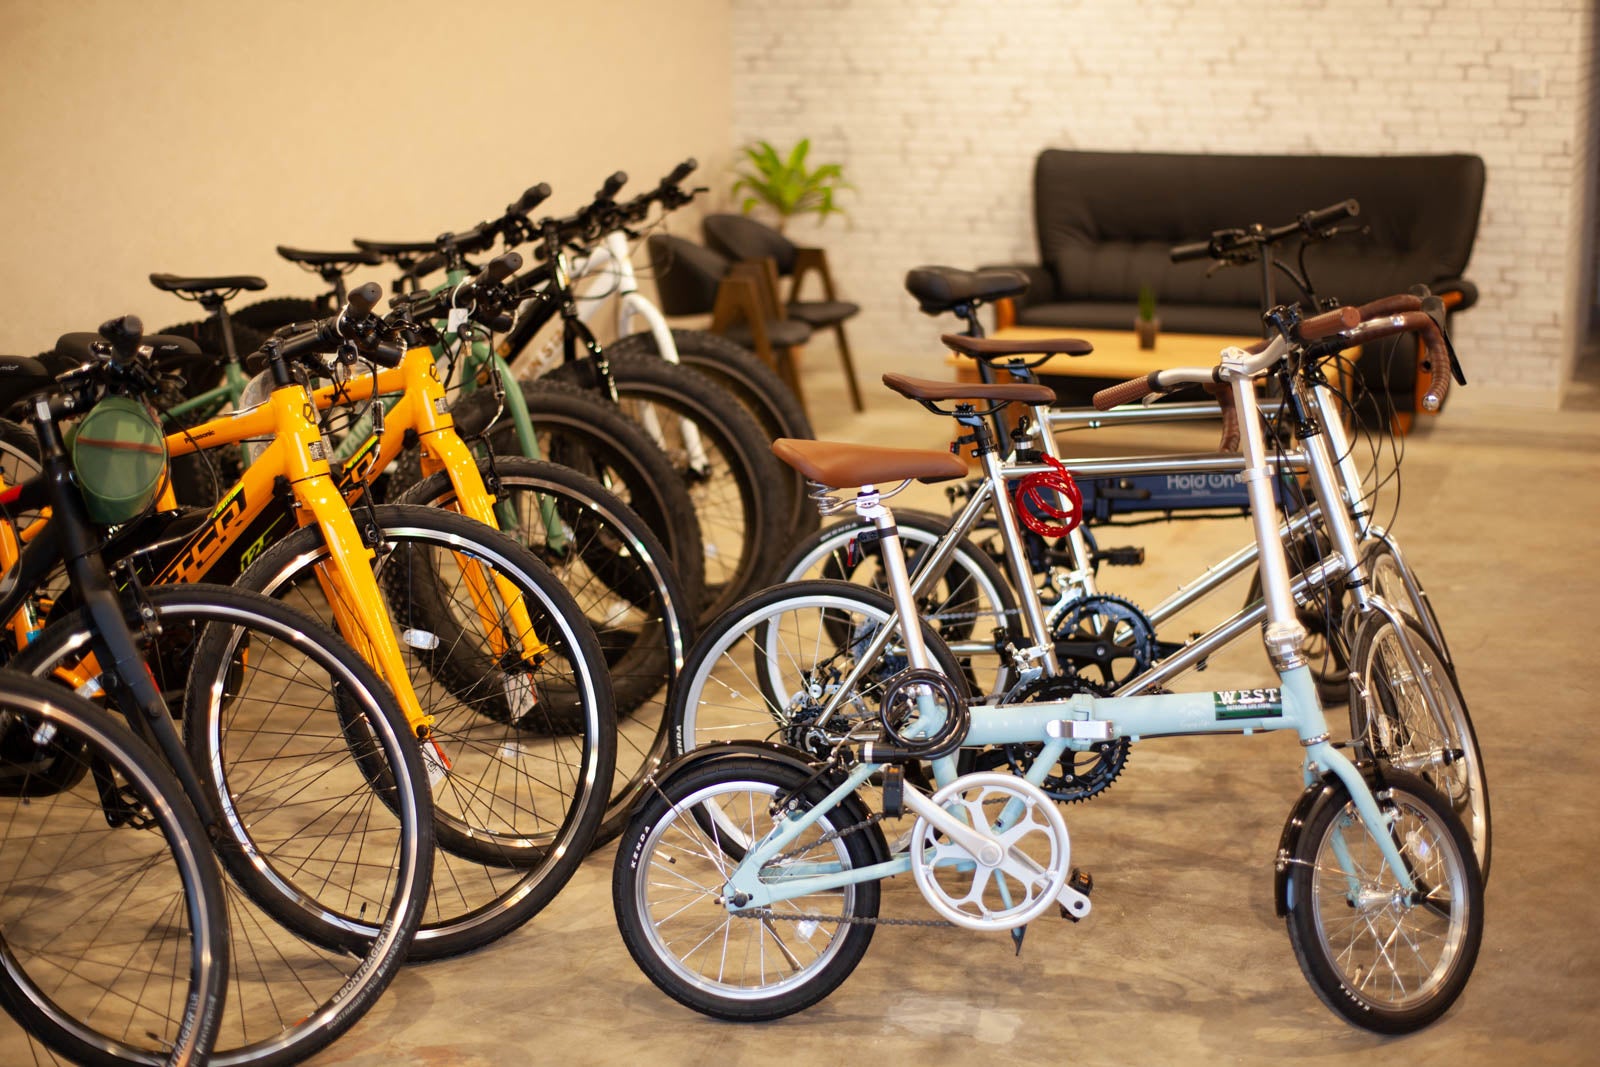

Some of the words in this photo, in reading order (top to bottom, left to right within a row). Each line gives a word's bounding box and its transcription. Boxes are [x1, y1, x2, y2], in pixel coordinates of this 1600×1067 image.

[1167, 473, 1206, 490] Hold
[1208, 473, 1235, 489] On
[1217, 688, 1278, 705] WEST
[676, 724, 684, 756] ENDA
[630, 825, 650, 869] KENDA
[339, 933, 388, 998] BONTRAGER
